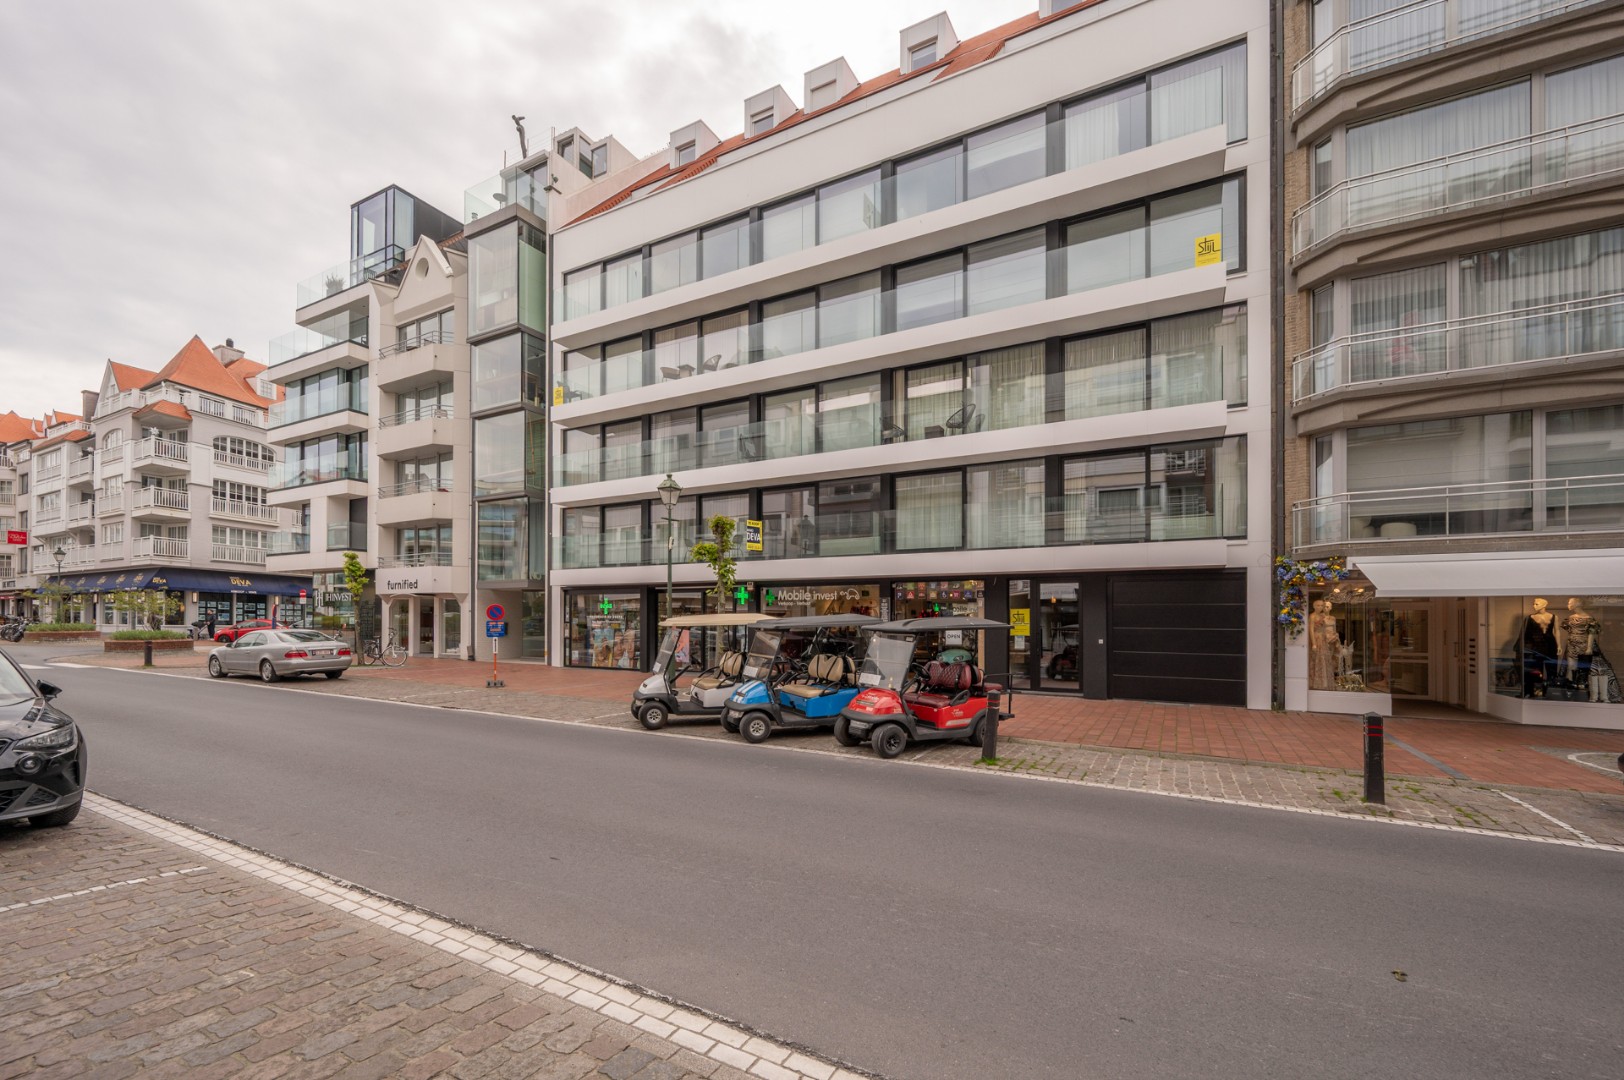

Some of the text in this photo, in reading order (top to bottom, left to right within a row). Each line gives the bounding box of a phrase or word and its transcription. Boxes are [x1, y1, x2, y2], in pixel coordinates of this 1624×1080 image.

[746, 532, 760, 542] DEVA
[387, 579, 418, 590] furnified
[777, 589, 837, 601] Mobile invest
